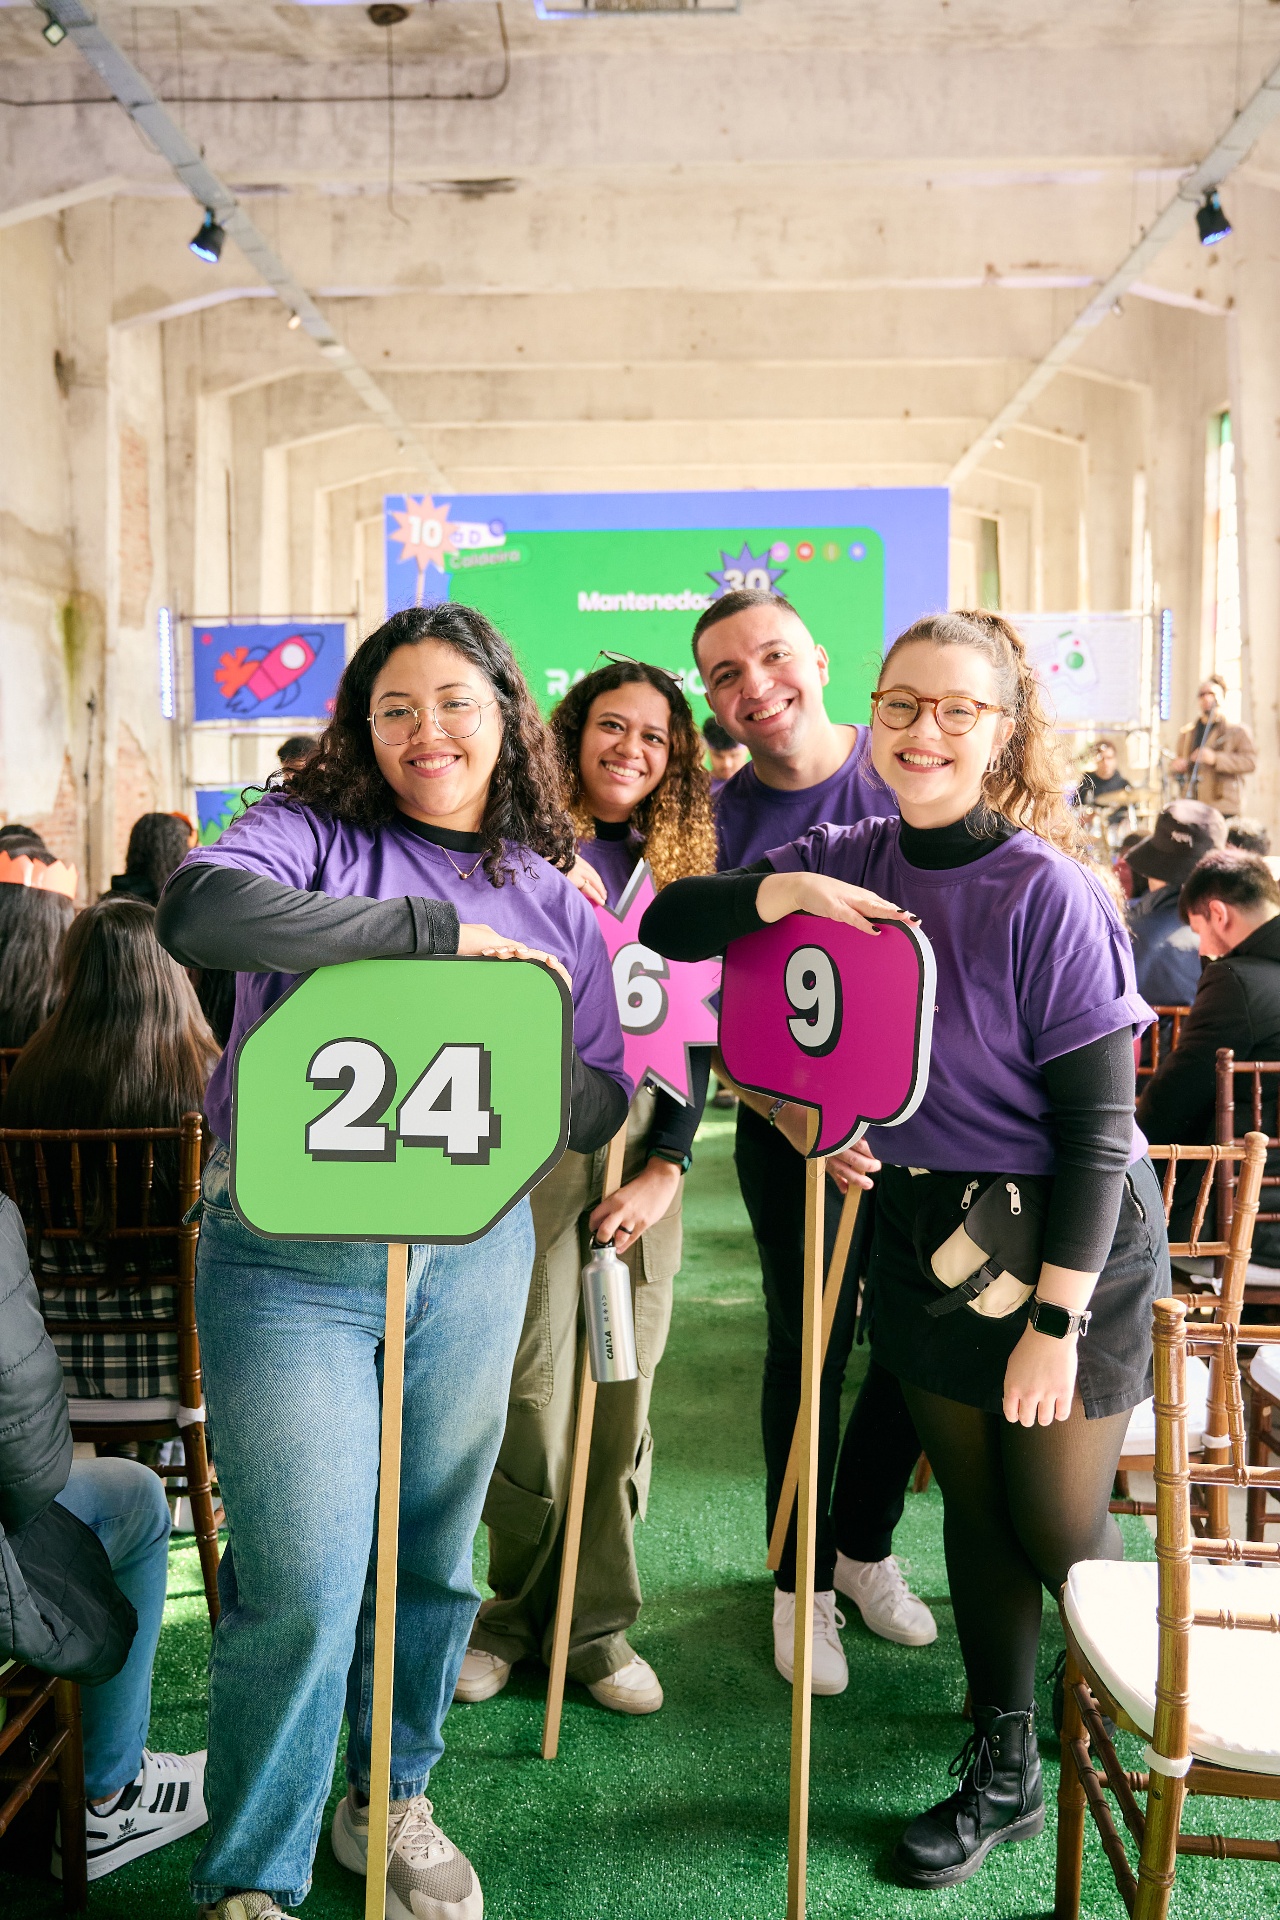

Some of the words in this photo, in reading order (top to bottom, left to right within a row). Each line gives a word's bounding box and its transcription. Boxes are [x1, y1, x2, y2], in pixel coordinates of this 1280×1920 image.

[408, 516, 443, 547] 10
[723, 569, 770, 594] 30
[612, 942, 668, 1034] 6
[784, 944, 841, 1054] 9
[305, 1037, 498, 1161] 24
